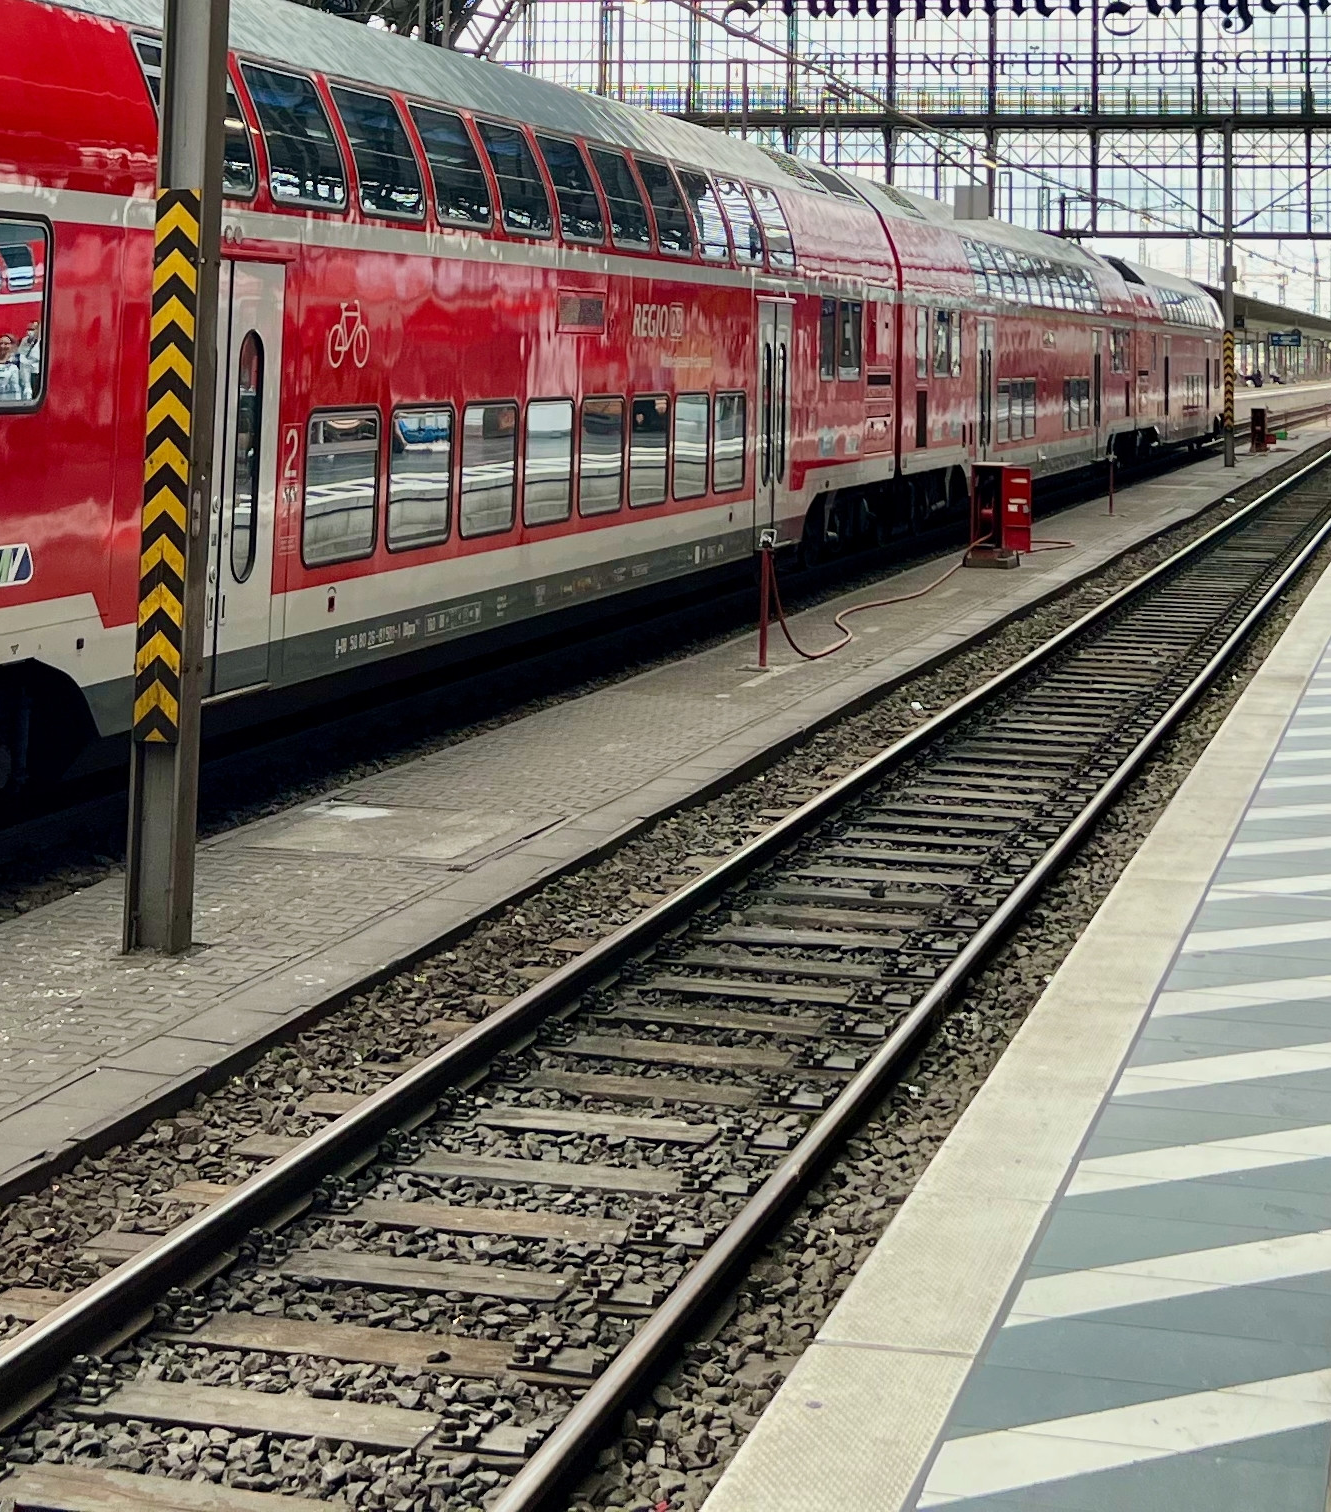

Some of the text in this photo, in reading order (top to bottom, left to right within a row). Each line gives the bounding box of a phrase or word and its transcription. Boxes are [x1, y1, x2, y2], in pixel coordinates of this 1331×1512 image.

[999, 45, 1075, 76] FÜR
[632, 303, 669, 338] REGIO
[284, 428, 299, 478] 2
